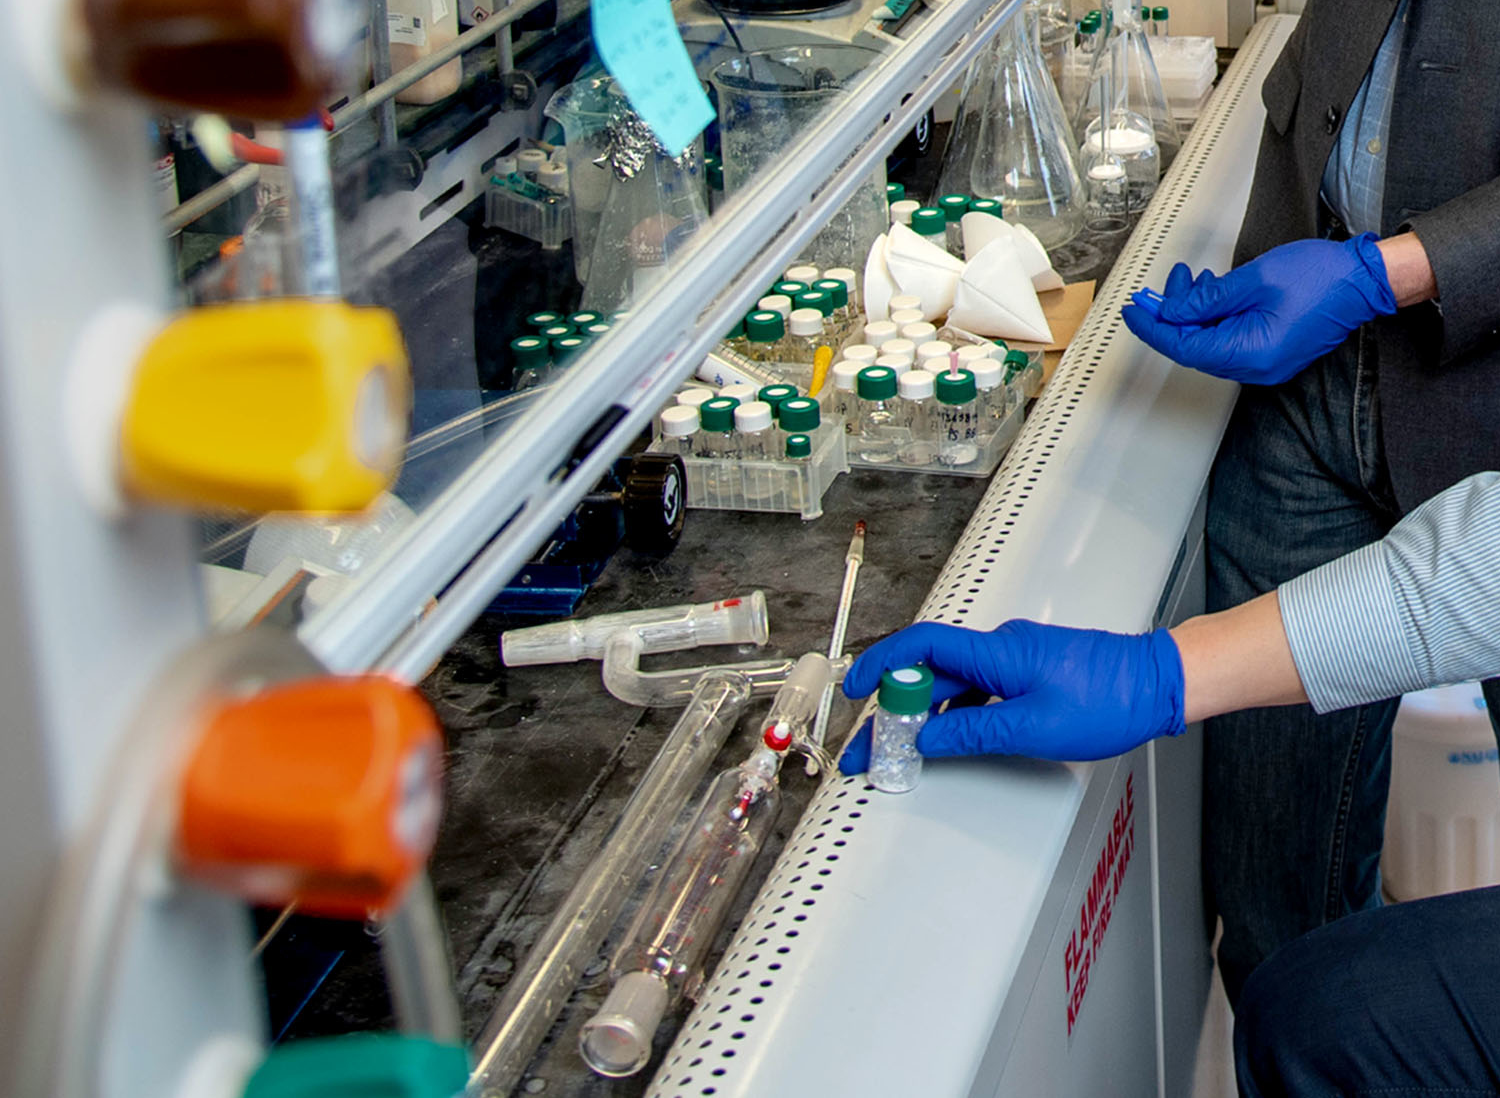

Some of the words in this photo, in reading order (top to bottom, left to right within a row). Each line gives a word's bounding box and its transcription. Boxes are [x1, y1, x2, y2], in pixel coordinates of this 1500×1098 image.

[1064, 771, 1134, 992] FLAMMABLE
[1066, 949, 1091, 1036] KEEP
[1092, 887, 1113, 963] FIRE
[1112, 819, 1135, 906] AWAY
